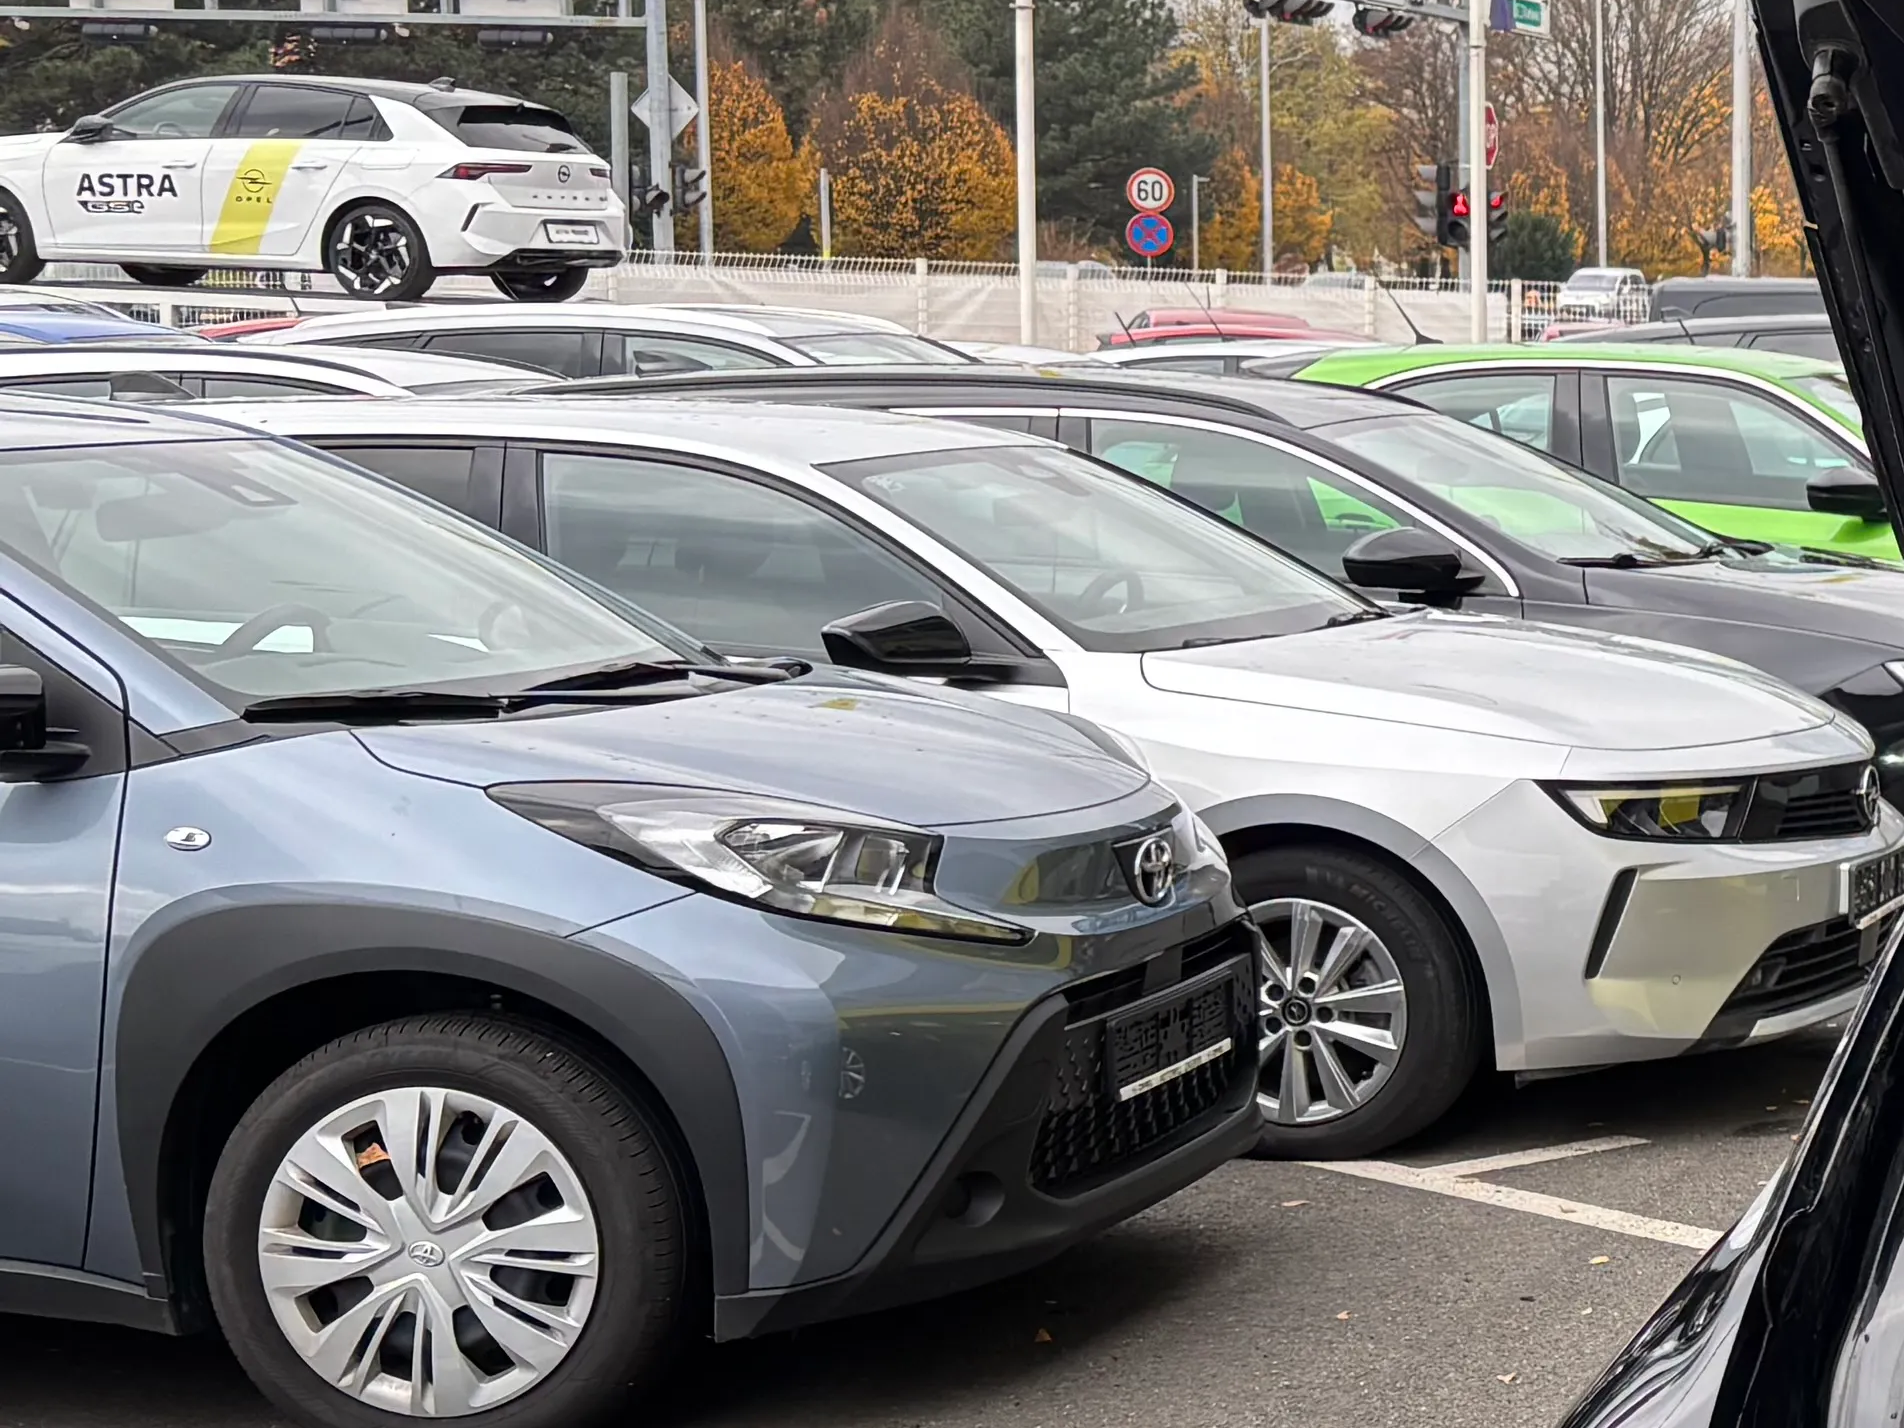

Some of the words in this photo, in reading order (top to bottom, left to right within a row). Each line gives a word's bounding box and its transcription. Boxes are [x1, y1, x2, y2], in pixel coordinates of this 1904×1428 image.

[76, 173, 179, 197] ASTRA
[1137, 179, 1163, 202] 60
[235, 195, 273, 204] OPEL
